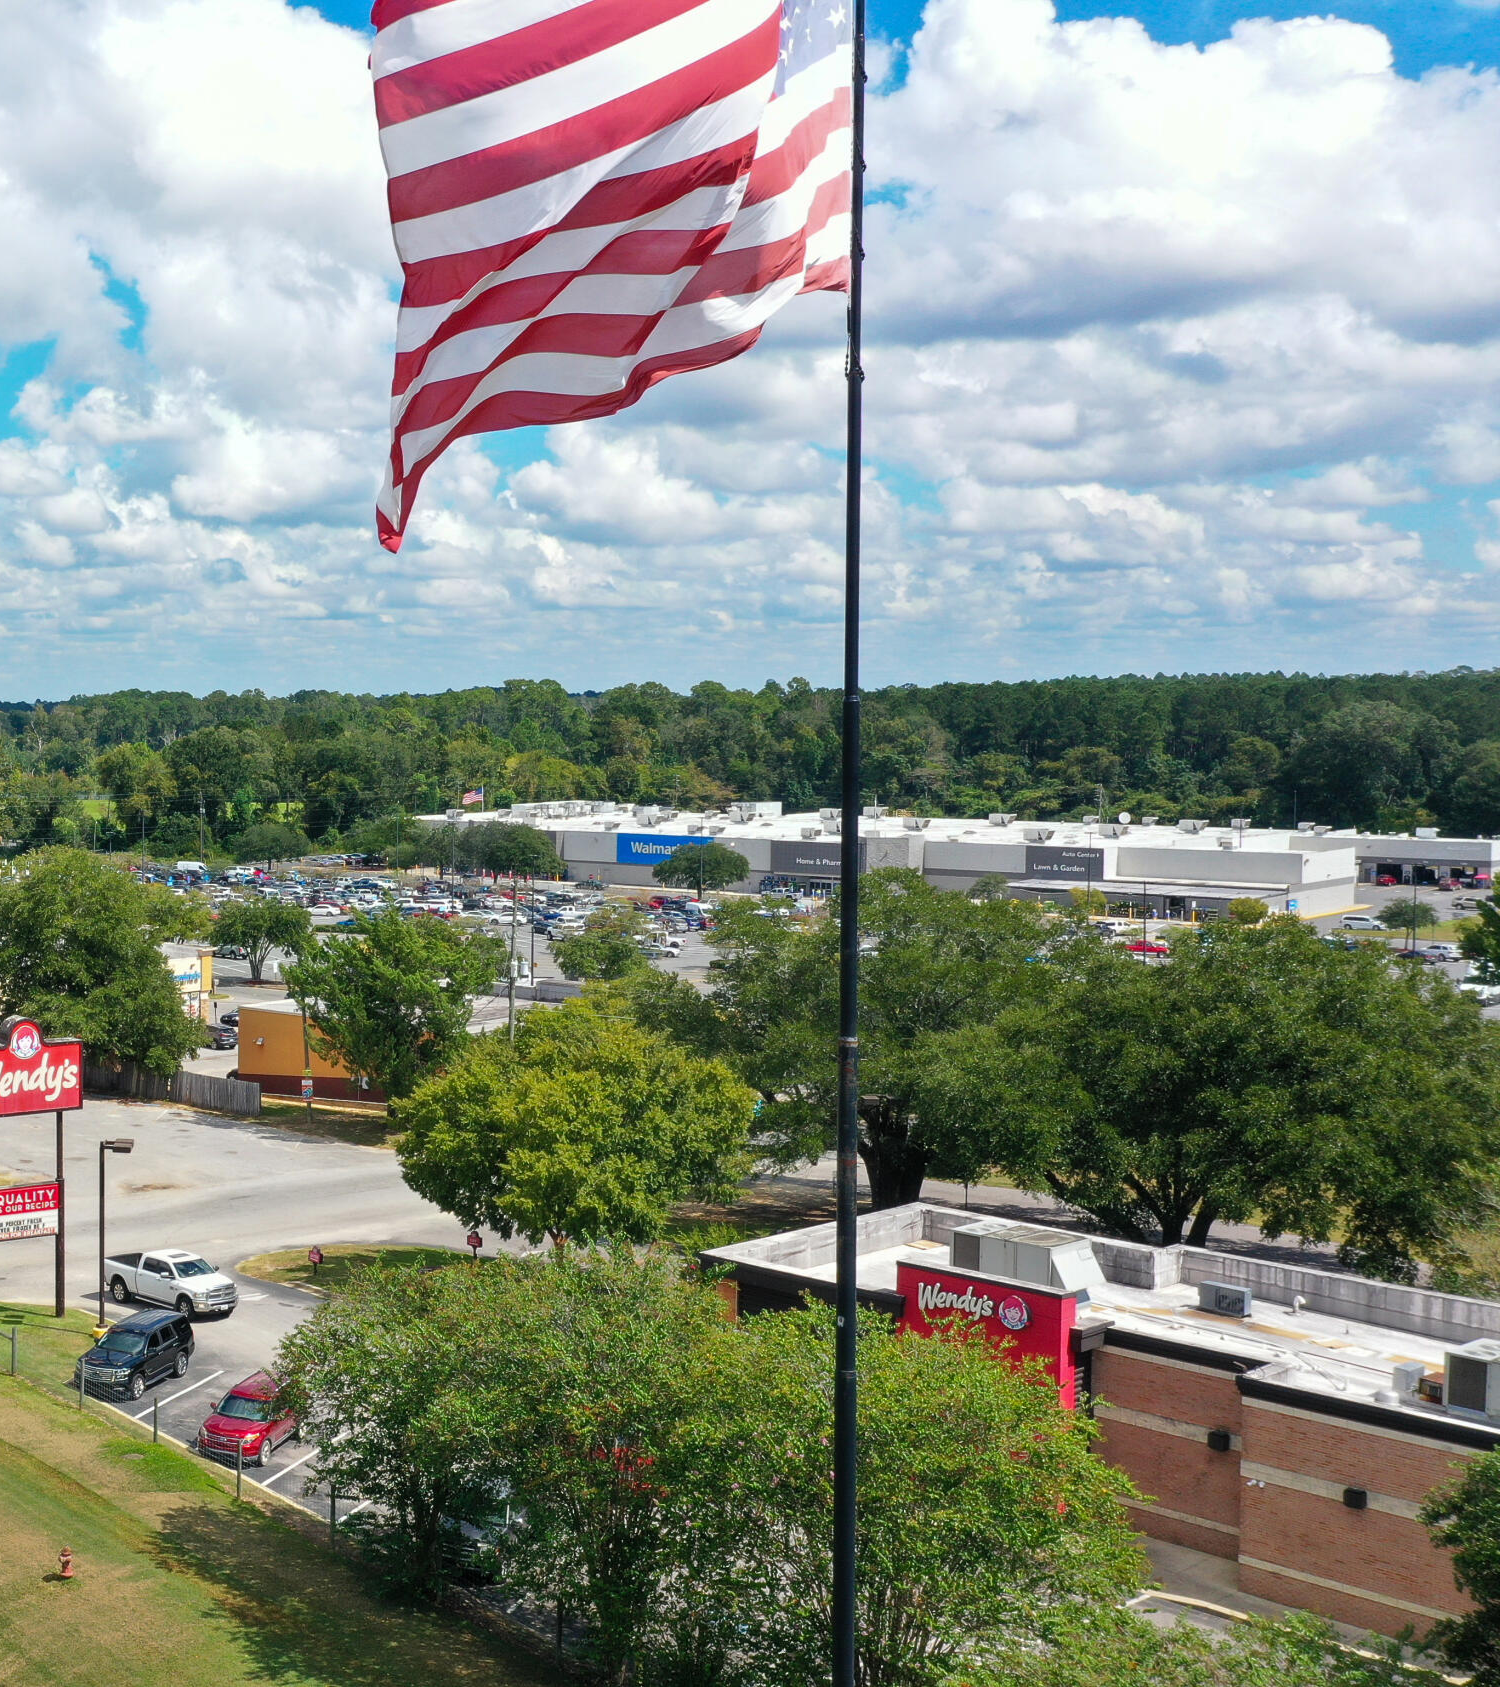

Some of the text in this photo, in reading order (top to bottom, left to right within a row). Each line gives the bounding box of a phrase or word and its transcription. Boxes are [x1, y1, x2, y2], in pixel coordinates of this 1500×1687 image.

[630, 841, 679, 855] Walmar
[796, 857, 814, 865] Home
[822, 858, 841, 866] Pharm
[1060, 864, 1085, 872] Garden
[5, 1205, 23, 1213] OUR
[25, 1201, 56, 1210] RECIPE
[918, 1282, 994, 1321] Wendy's
